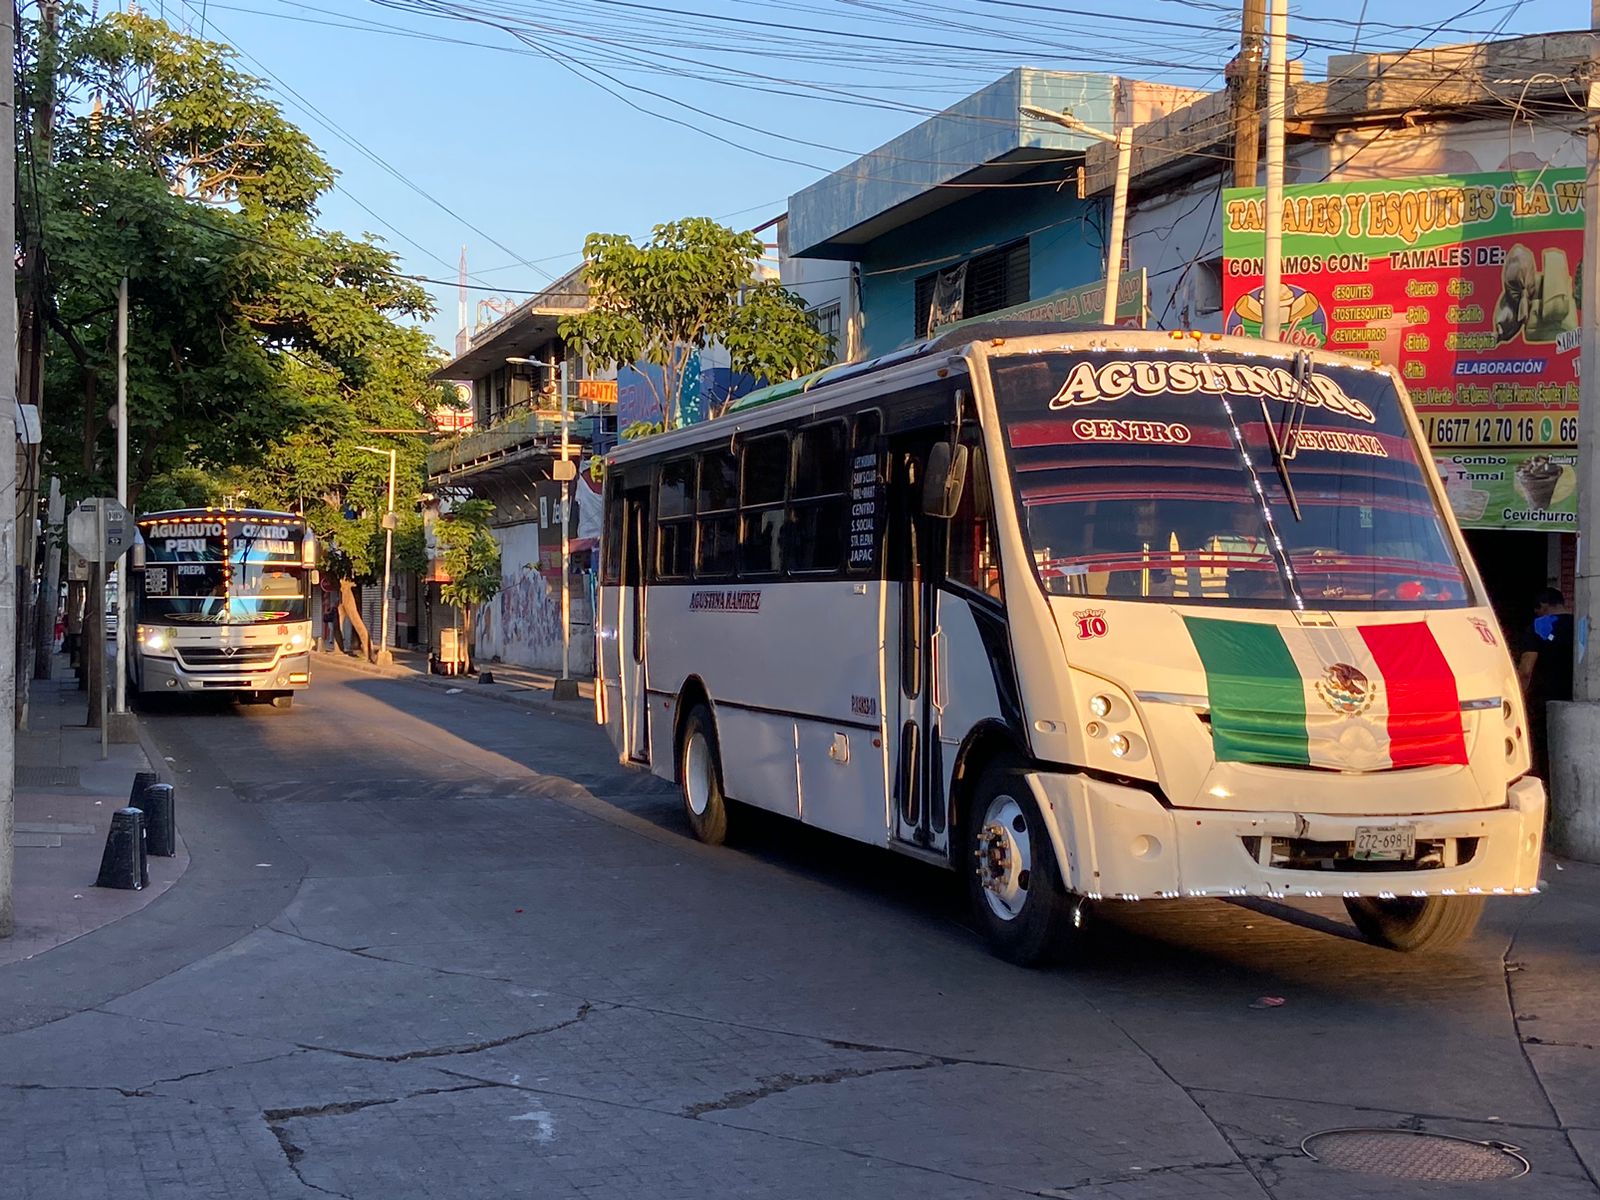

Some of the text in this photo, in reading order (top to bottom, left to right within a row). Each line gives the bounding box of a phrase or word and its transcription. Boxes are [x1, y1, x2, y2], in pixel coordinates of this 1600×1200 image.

[1227, 196, 1343, 235] TAALES
[1346, 194, 1366, 236] Y
[1368, 186, 1496, 243] ESQUITES
[1230, 254, 1368, 276] CONMOS CON:
[1390, 247, 1505, 269] TAMALES DE:
[1456, 361, 1543, 374] ELABORACIÓN
[1072, 419, 1191, 443] CENTRO
[1437, 418, 1470, 442] 6677
[1475, 418, 1491, 442] 12
[1496, 417, 1512, 442] 70
[1517, 417, 1534, 442] 16
[1321, 431, 1388, 457] HUMAYA
[1452, 455, 1507, 465] Combo
[1456, 471, 1504, 480] Tamal
[852, 502, 875, 516] CENTRO
[150, 523, 222, 538] AGUARUTO
[242, 525, 289, 539] CENTRO
[165, 538, 207, 553] PENI
[850, 548, 873, 562] JAPAC
[178, 565, 206, 575] PREPA
[689, 591, 761, 610] AGUSTINA RAMIREZ
[1075, 616, 1109, 640] 10
